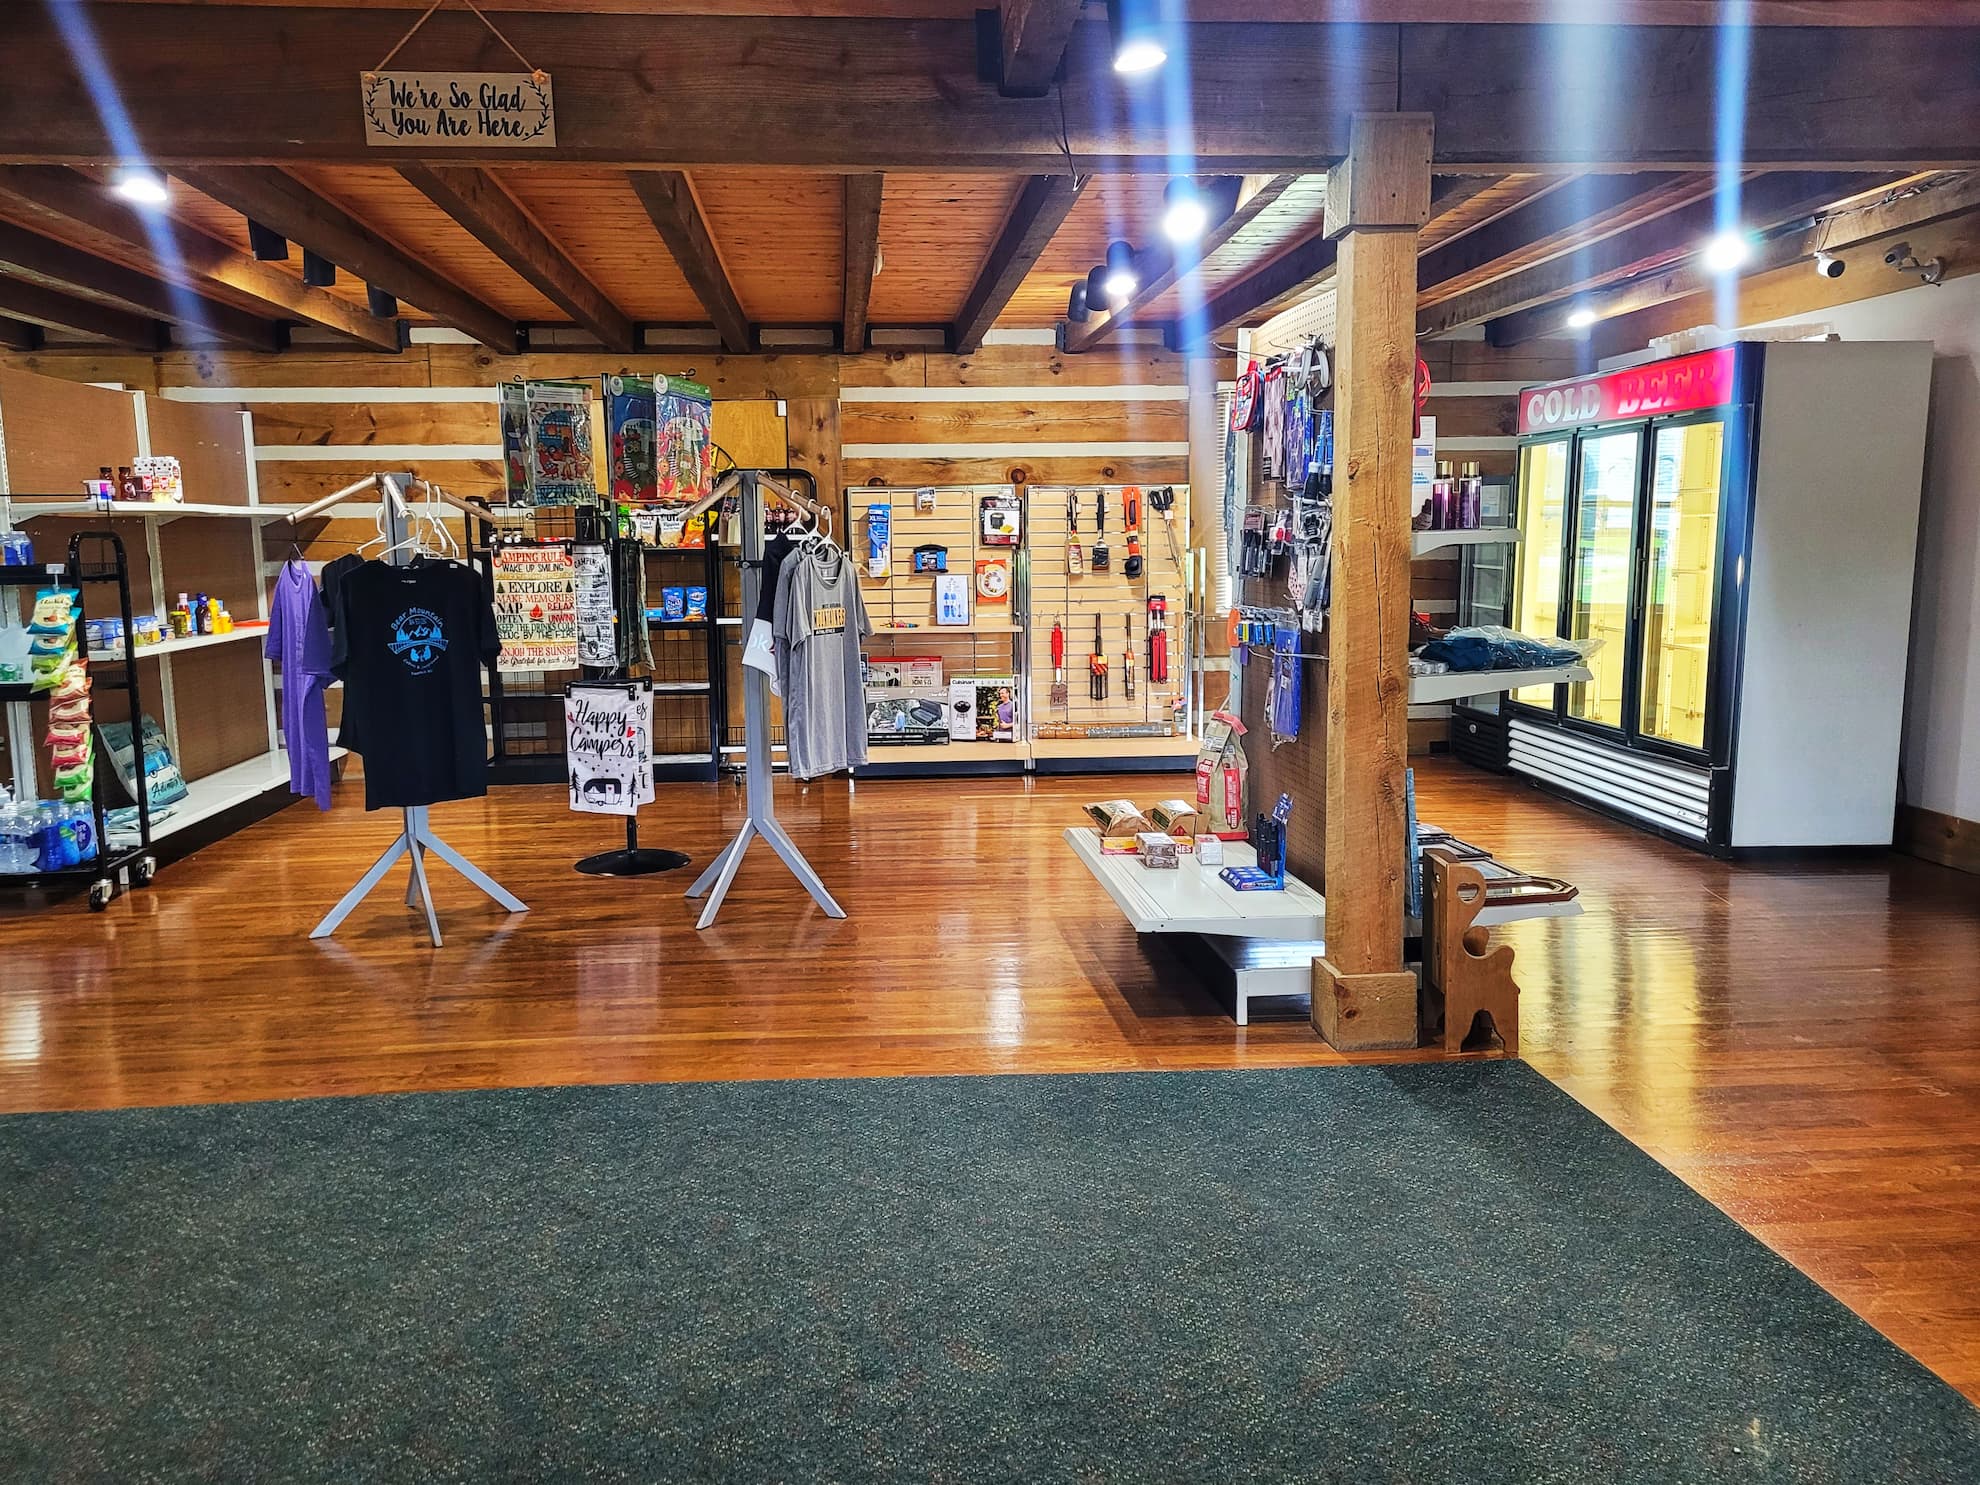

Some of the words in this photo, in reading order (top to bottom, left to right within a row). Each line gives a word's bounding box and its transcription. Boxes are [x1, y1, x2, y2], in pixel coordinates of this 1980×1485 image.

[389, 79, 441, 108] We're
[449, 82, 473, 108] So
[479, 83, 526, 112] Glad
[391, 108, 431, 135] You
[436, 109, 471, 136] Are
[478, 109, 530, 137] Here.
[1526, 383, 1600, 426] COLD
[1616, 358, 1719, 414] BEER
[493, 551, 539, 568] CAMPING
[502, 563, 522, 573] WAKE
[525, 563, 534, 573] UP
[538, 562, 564, 573] SMILING
[508, 581, 563, 593] EXPLORE
[496, 594, 524, 603] MAKE
[526, 593, 575, 603] MEMORIES
[497, 602, 523, 614] NAP
[547, 602, 575, 611] RELAX
[390, 612, 407, 631] Bear
[409, 606, 444, 628] Mountain
[496, 614, 524, 624] OFTEN
[548, 614, 575, 623] UNWIND
[497, 623, 514, 632] KEEP
[516, 623, 531, 632] THE
[532, 622, 556, 632] DRINKS
[558, 622, 577, 632] COLD
[523, 631, 534, 640] BY
[538, 630, 553, 640] THE
[555, 630, 577, 639] FIRE
[527, 646, 544, 657] THE
[545, 646, 577, 657] SUNSET
[575, 699, 627, 736] Happy
[570, 726, 636, 760] Campers
